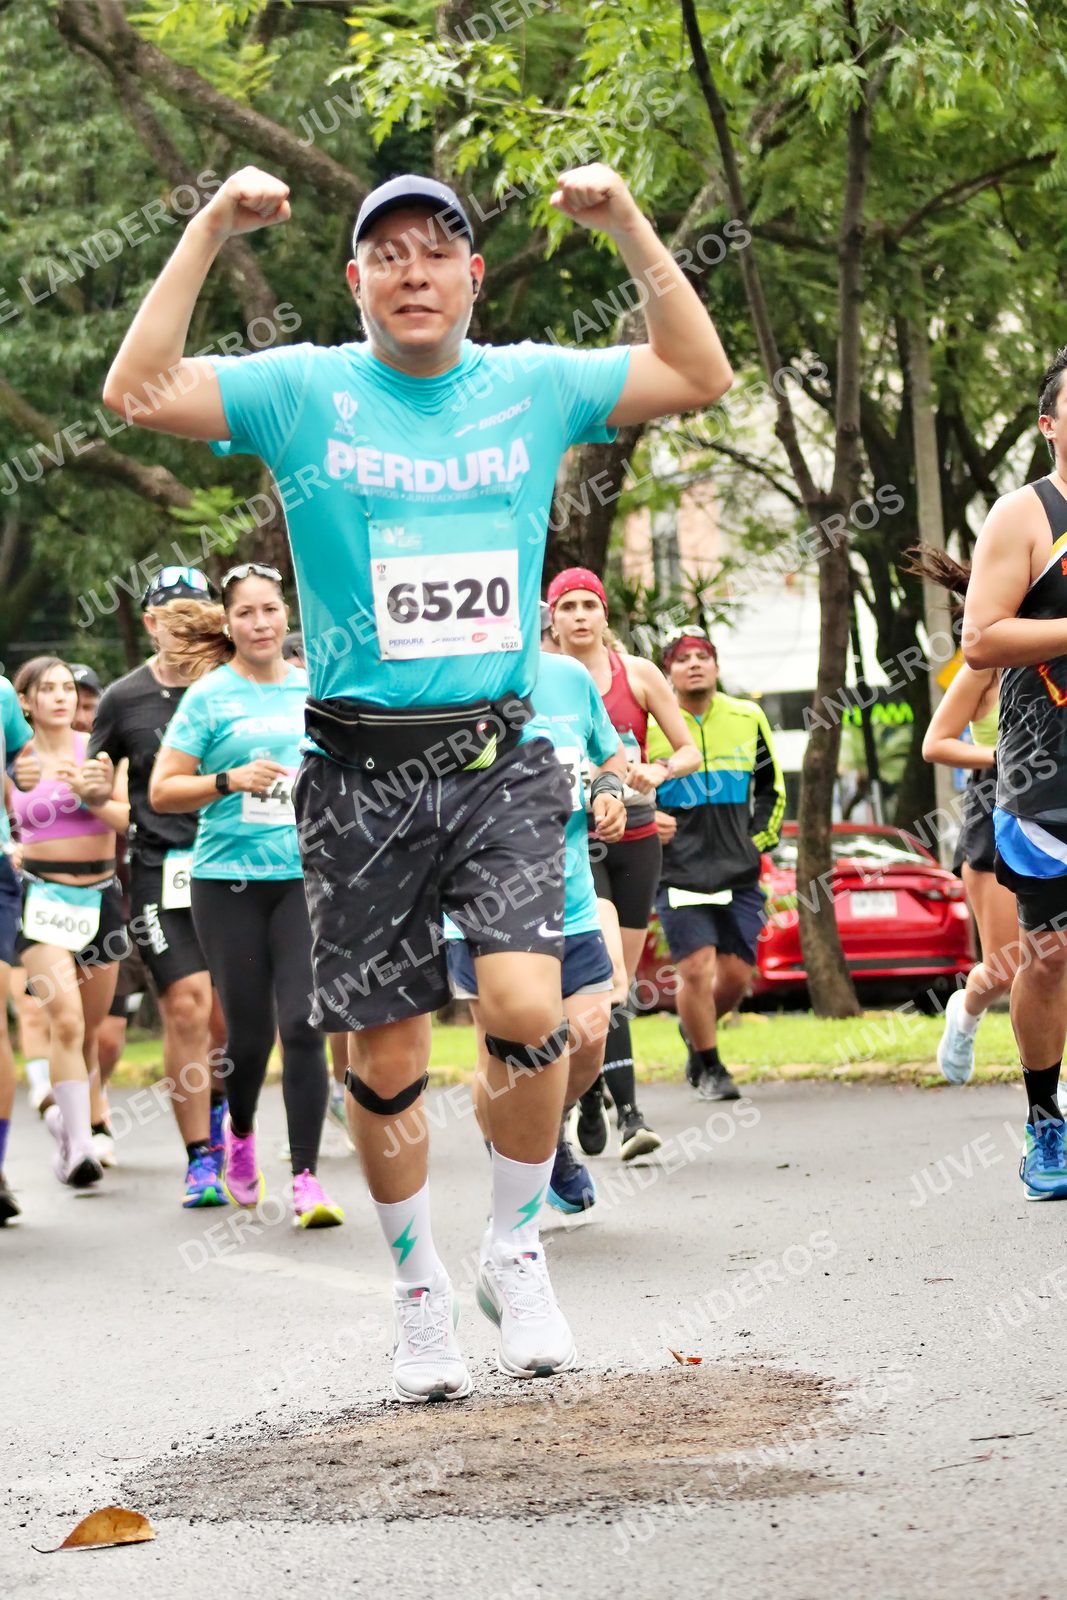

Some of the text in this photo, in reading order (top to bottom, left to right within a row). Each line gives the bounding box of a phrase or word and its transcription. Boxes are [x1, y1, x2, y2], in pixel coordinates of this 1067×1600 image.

[479, 396, 532, 430] BROOKS
[327, 437, 530, 492] PERDURA
[387, 577, 510, 624] 6520
[34, 911, 91, 935] 5400
